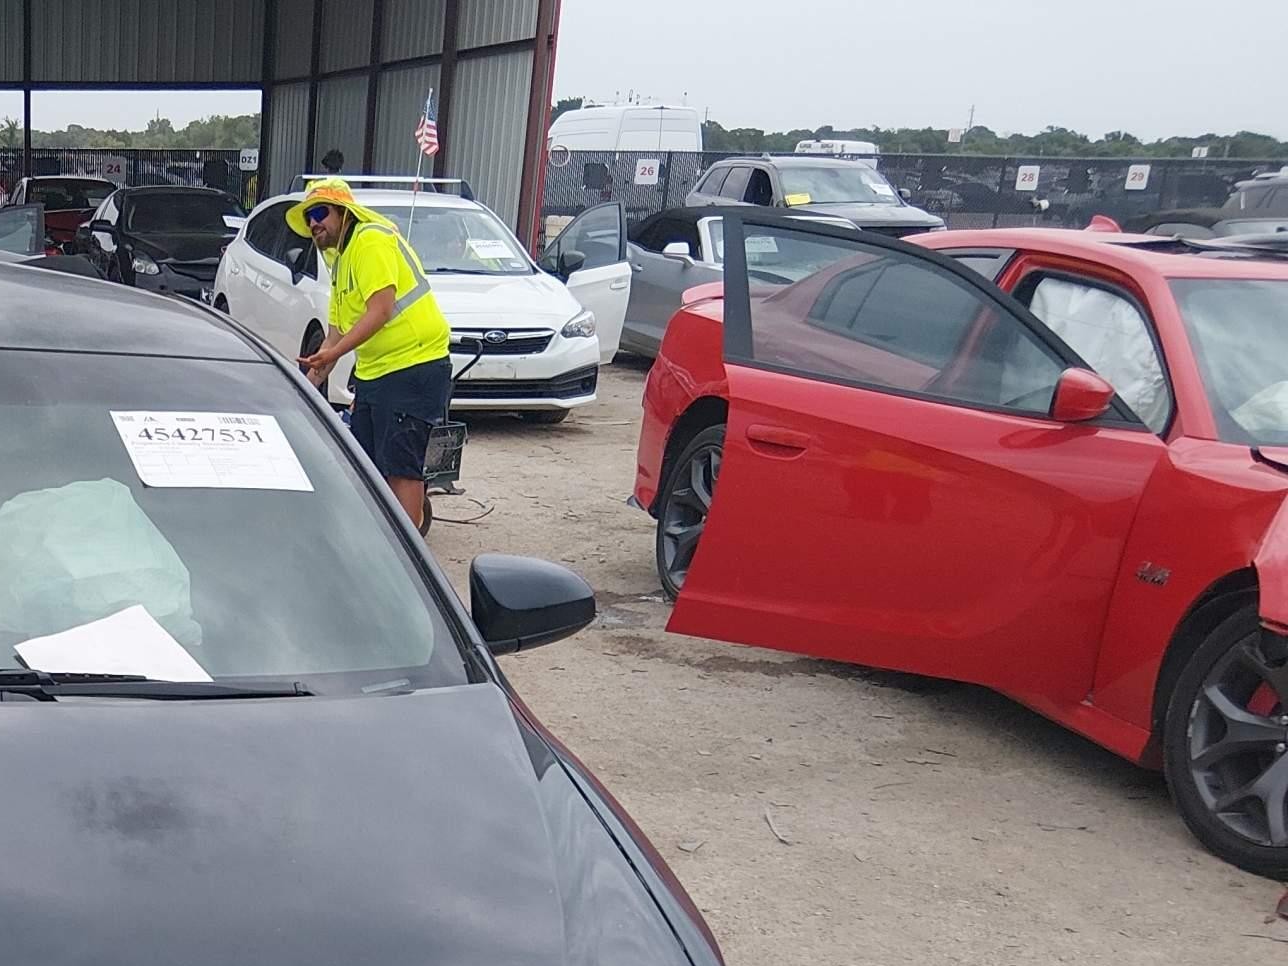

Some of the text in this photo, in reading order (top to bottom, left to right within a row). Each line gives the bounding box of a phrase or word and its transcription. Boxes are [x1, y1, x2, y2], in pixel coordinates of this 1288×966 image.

[241, 155, 257, 164] DZ1
[106, 164, 121, 174] 24
[639, 166, 654, 176] 26
[1021, 172, 1035, 183] 28
[1128, 171, 1144, 182] 29
[138, 427, 265, 444] 45427531
